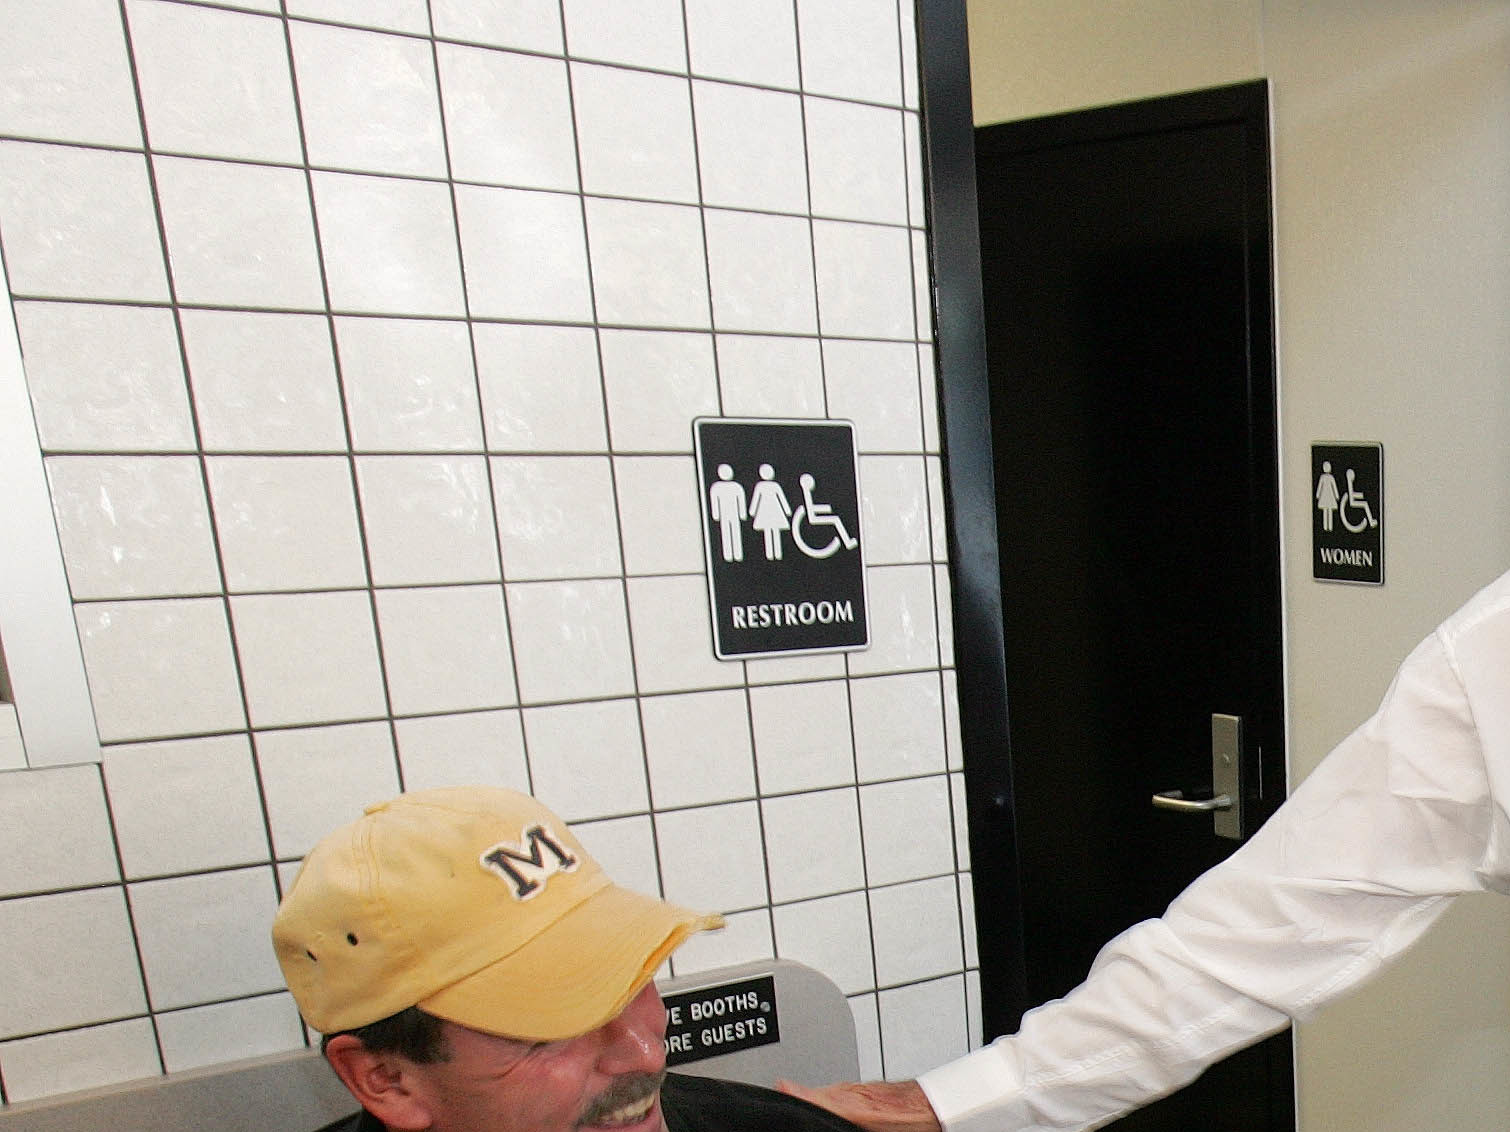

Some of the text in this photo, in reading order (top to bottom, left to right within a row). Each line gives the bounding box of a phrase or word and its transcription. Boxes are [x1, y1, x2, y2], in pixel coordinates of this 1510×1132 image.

[1320, 547, 1373, 567] WOMEN
[731, 601, 855, 630] RESTROOM
[481, 824, 579, 900] M
[690, 991, 759, 1022] BOOTHS
[701, 1017, 768, 1047] GUESTS
